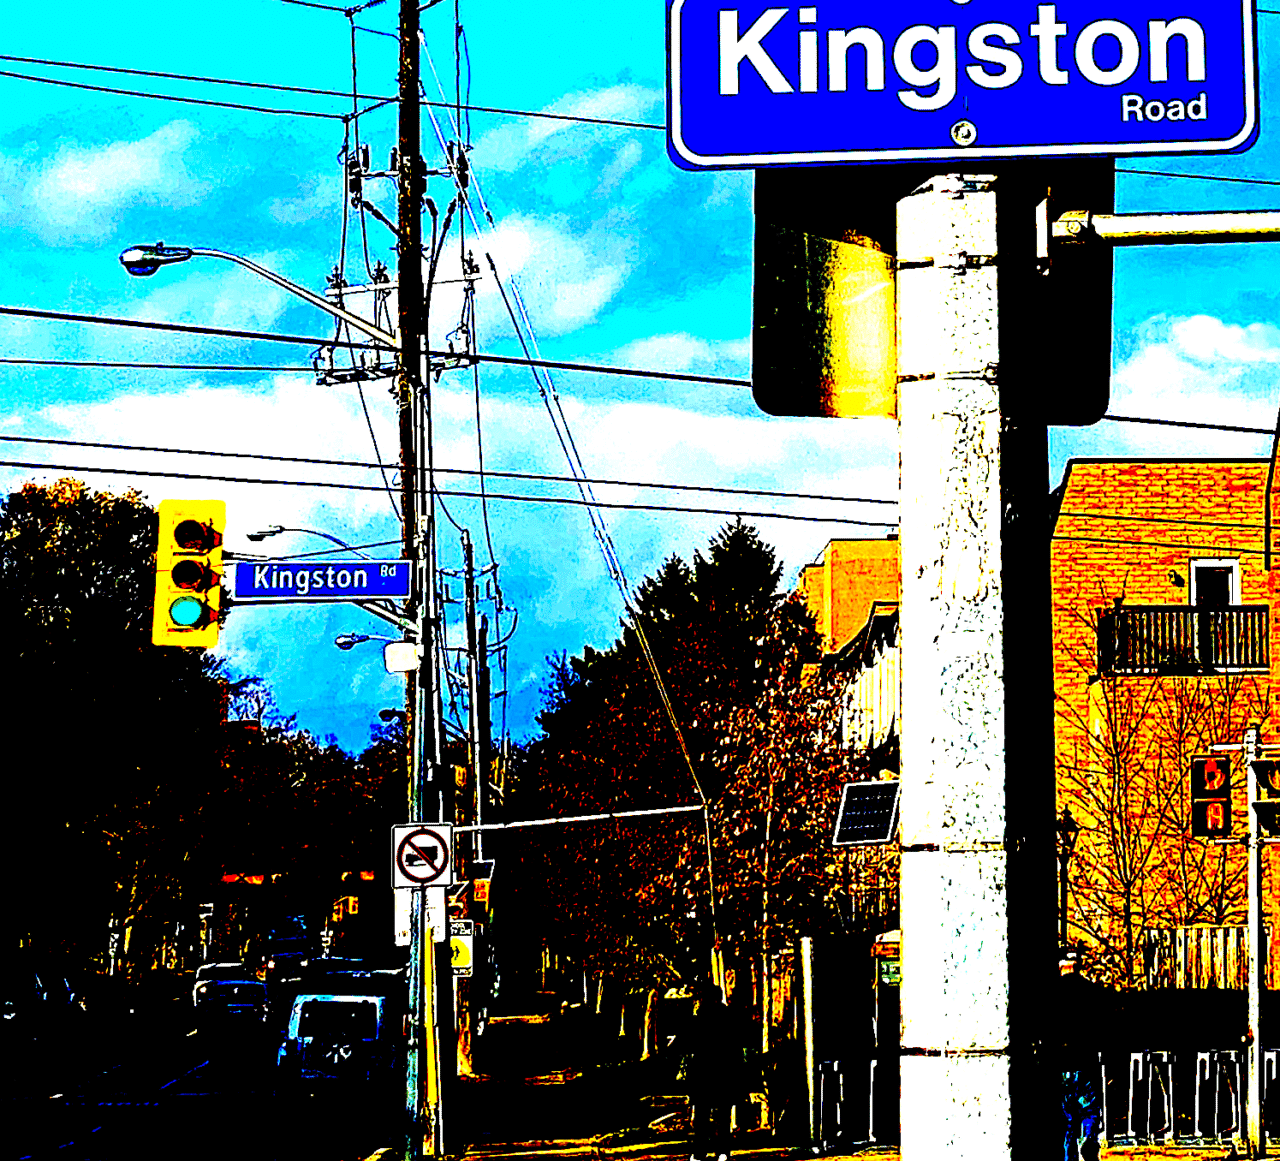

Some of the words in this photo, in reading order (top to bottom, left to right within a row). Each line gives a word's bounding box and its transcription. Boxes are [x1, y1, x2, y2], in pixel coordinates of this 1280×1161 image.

[718, 4, 1206, 111] Kingston
[1122, 93, 1206, 121] Road
[254, 565, 367, 594] Kingston
[380, 564, 397, 577] Rd
